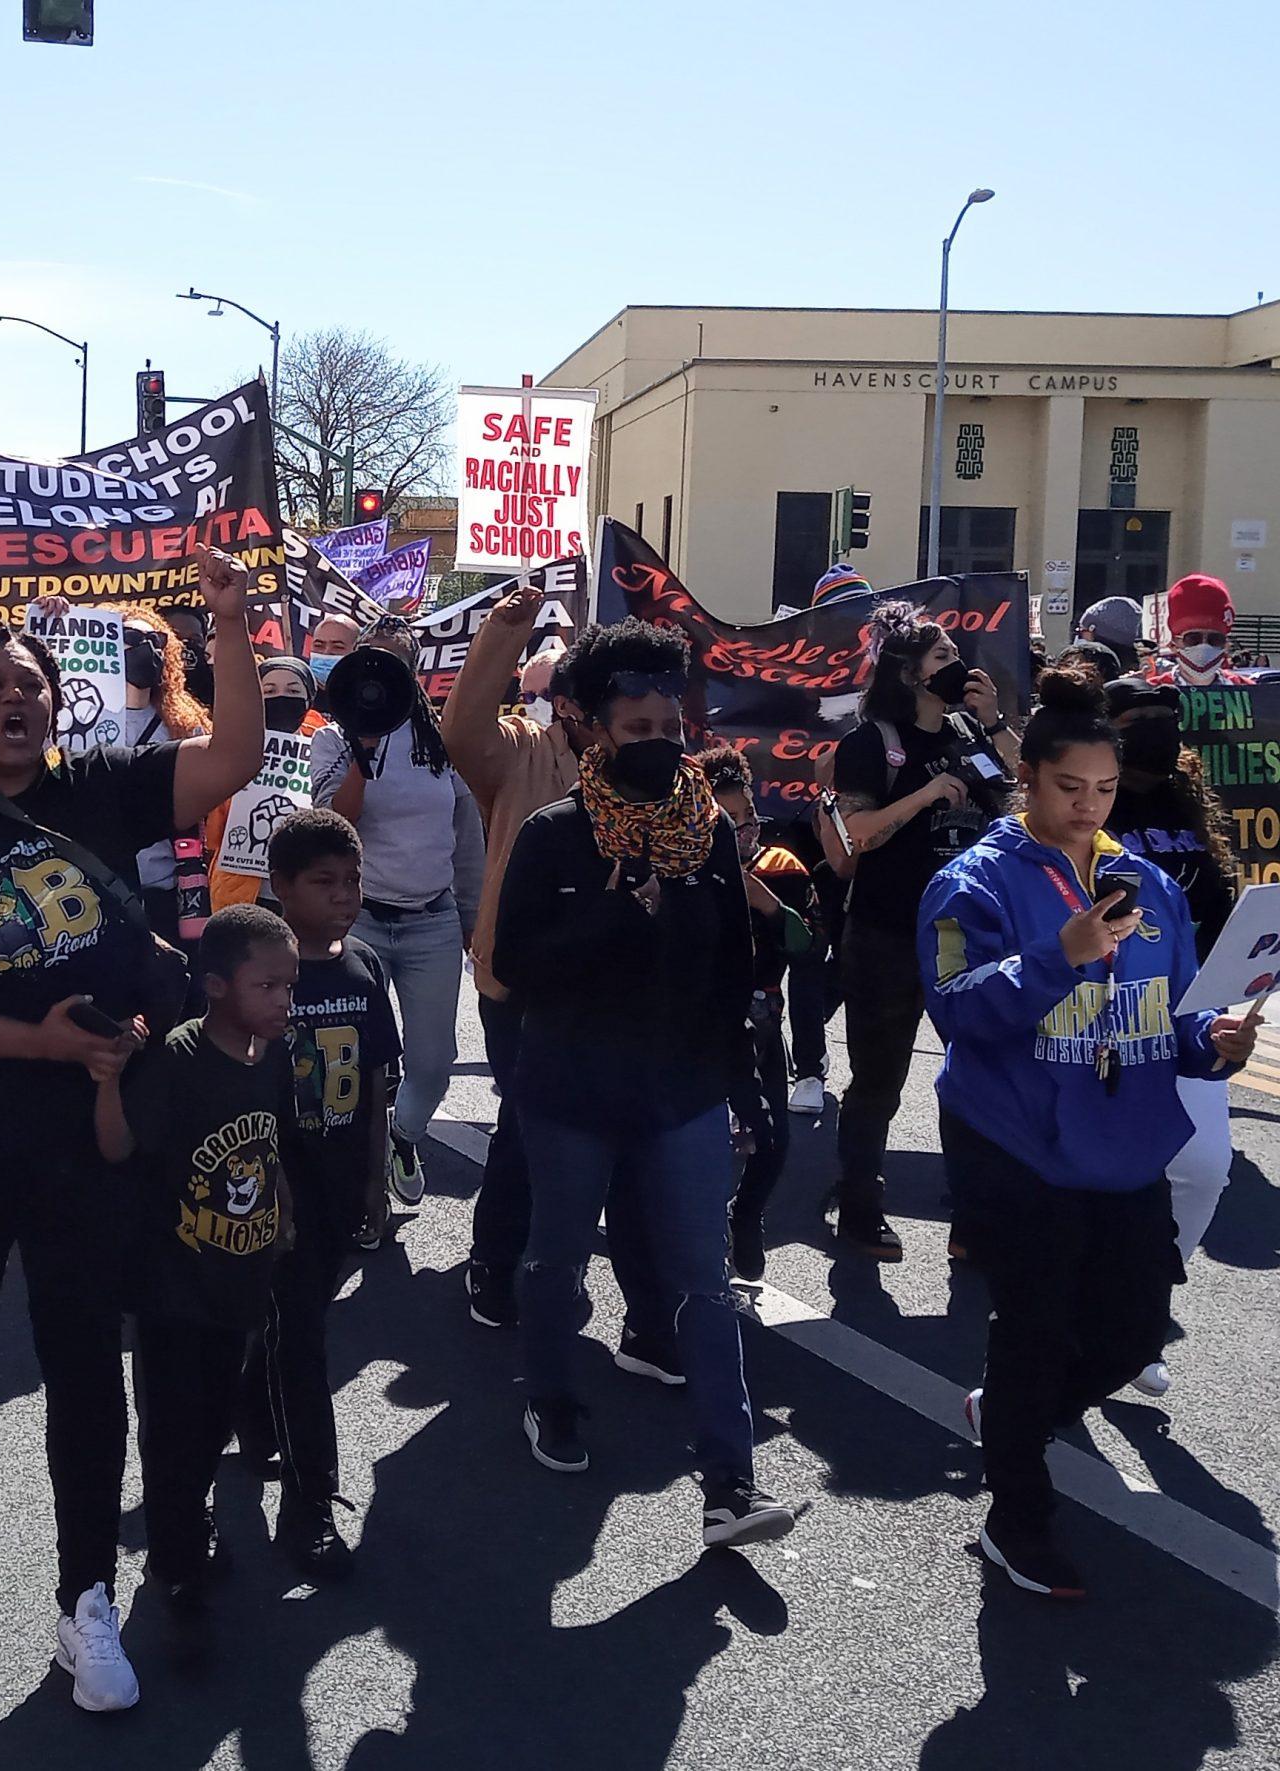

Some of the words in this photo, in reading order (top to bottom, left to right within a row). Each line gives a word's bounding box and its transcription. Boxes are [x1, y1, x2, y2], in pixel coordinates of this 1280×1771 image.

[1029, 374, 1118, 391] CAMPUS
[96, 396, 257, 478] CHOOL
[482, 413, 573, 447] SAFE
[510, 446, 541, 458] AND
[466, 458, 581, 496] RACIALLY
[194, 475, 233, 519] AT
[494, 494, 558, 527] JUST
[470, 523, 581, 560] SCHOOLS
[29, 616, 119, 641] HANDS
[827, 602, 1011, 666] Sool
[47, 637, 71, 656] FF
[74, 639, 118, 657] OUR
[57, 658, 120, 675] HOOLS
[703, 644, 871, 689] Escuel
[1178, 690, 1254, 732] OPEN!
[264, 756, 281, 770] FF
[283, 760, 311, 777] OU
[265, 737, 311, 761] AND
[1192, 741, 1280, 786] MILIES
[253, 773, 311, 795] CHOOL
[1231, 807, 1280, 850] TO
[236, 857, 253, 865] CUTS
[10, 857, 102, 948] B
[44, 929, 99, 968] Lions
[290, 997, 368, 1017] Brookfield
[1034, 1036, 1145, 1066] BASKEALL
[315, 1025, 360, 1113] B
[209, 1212, 277, 1253] LIONS
